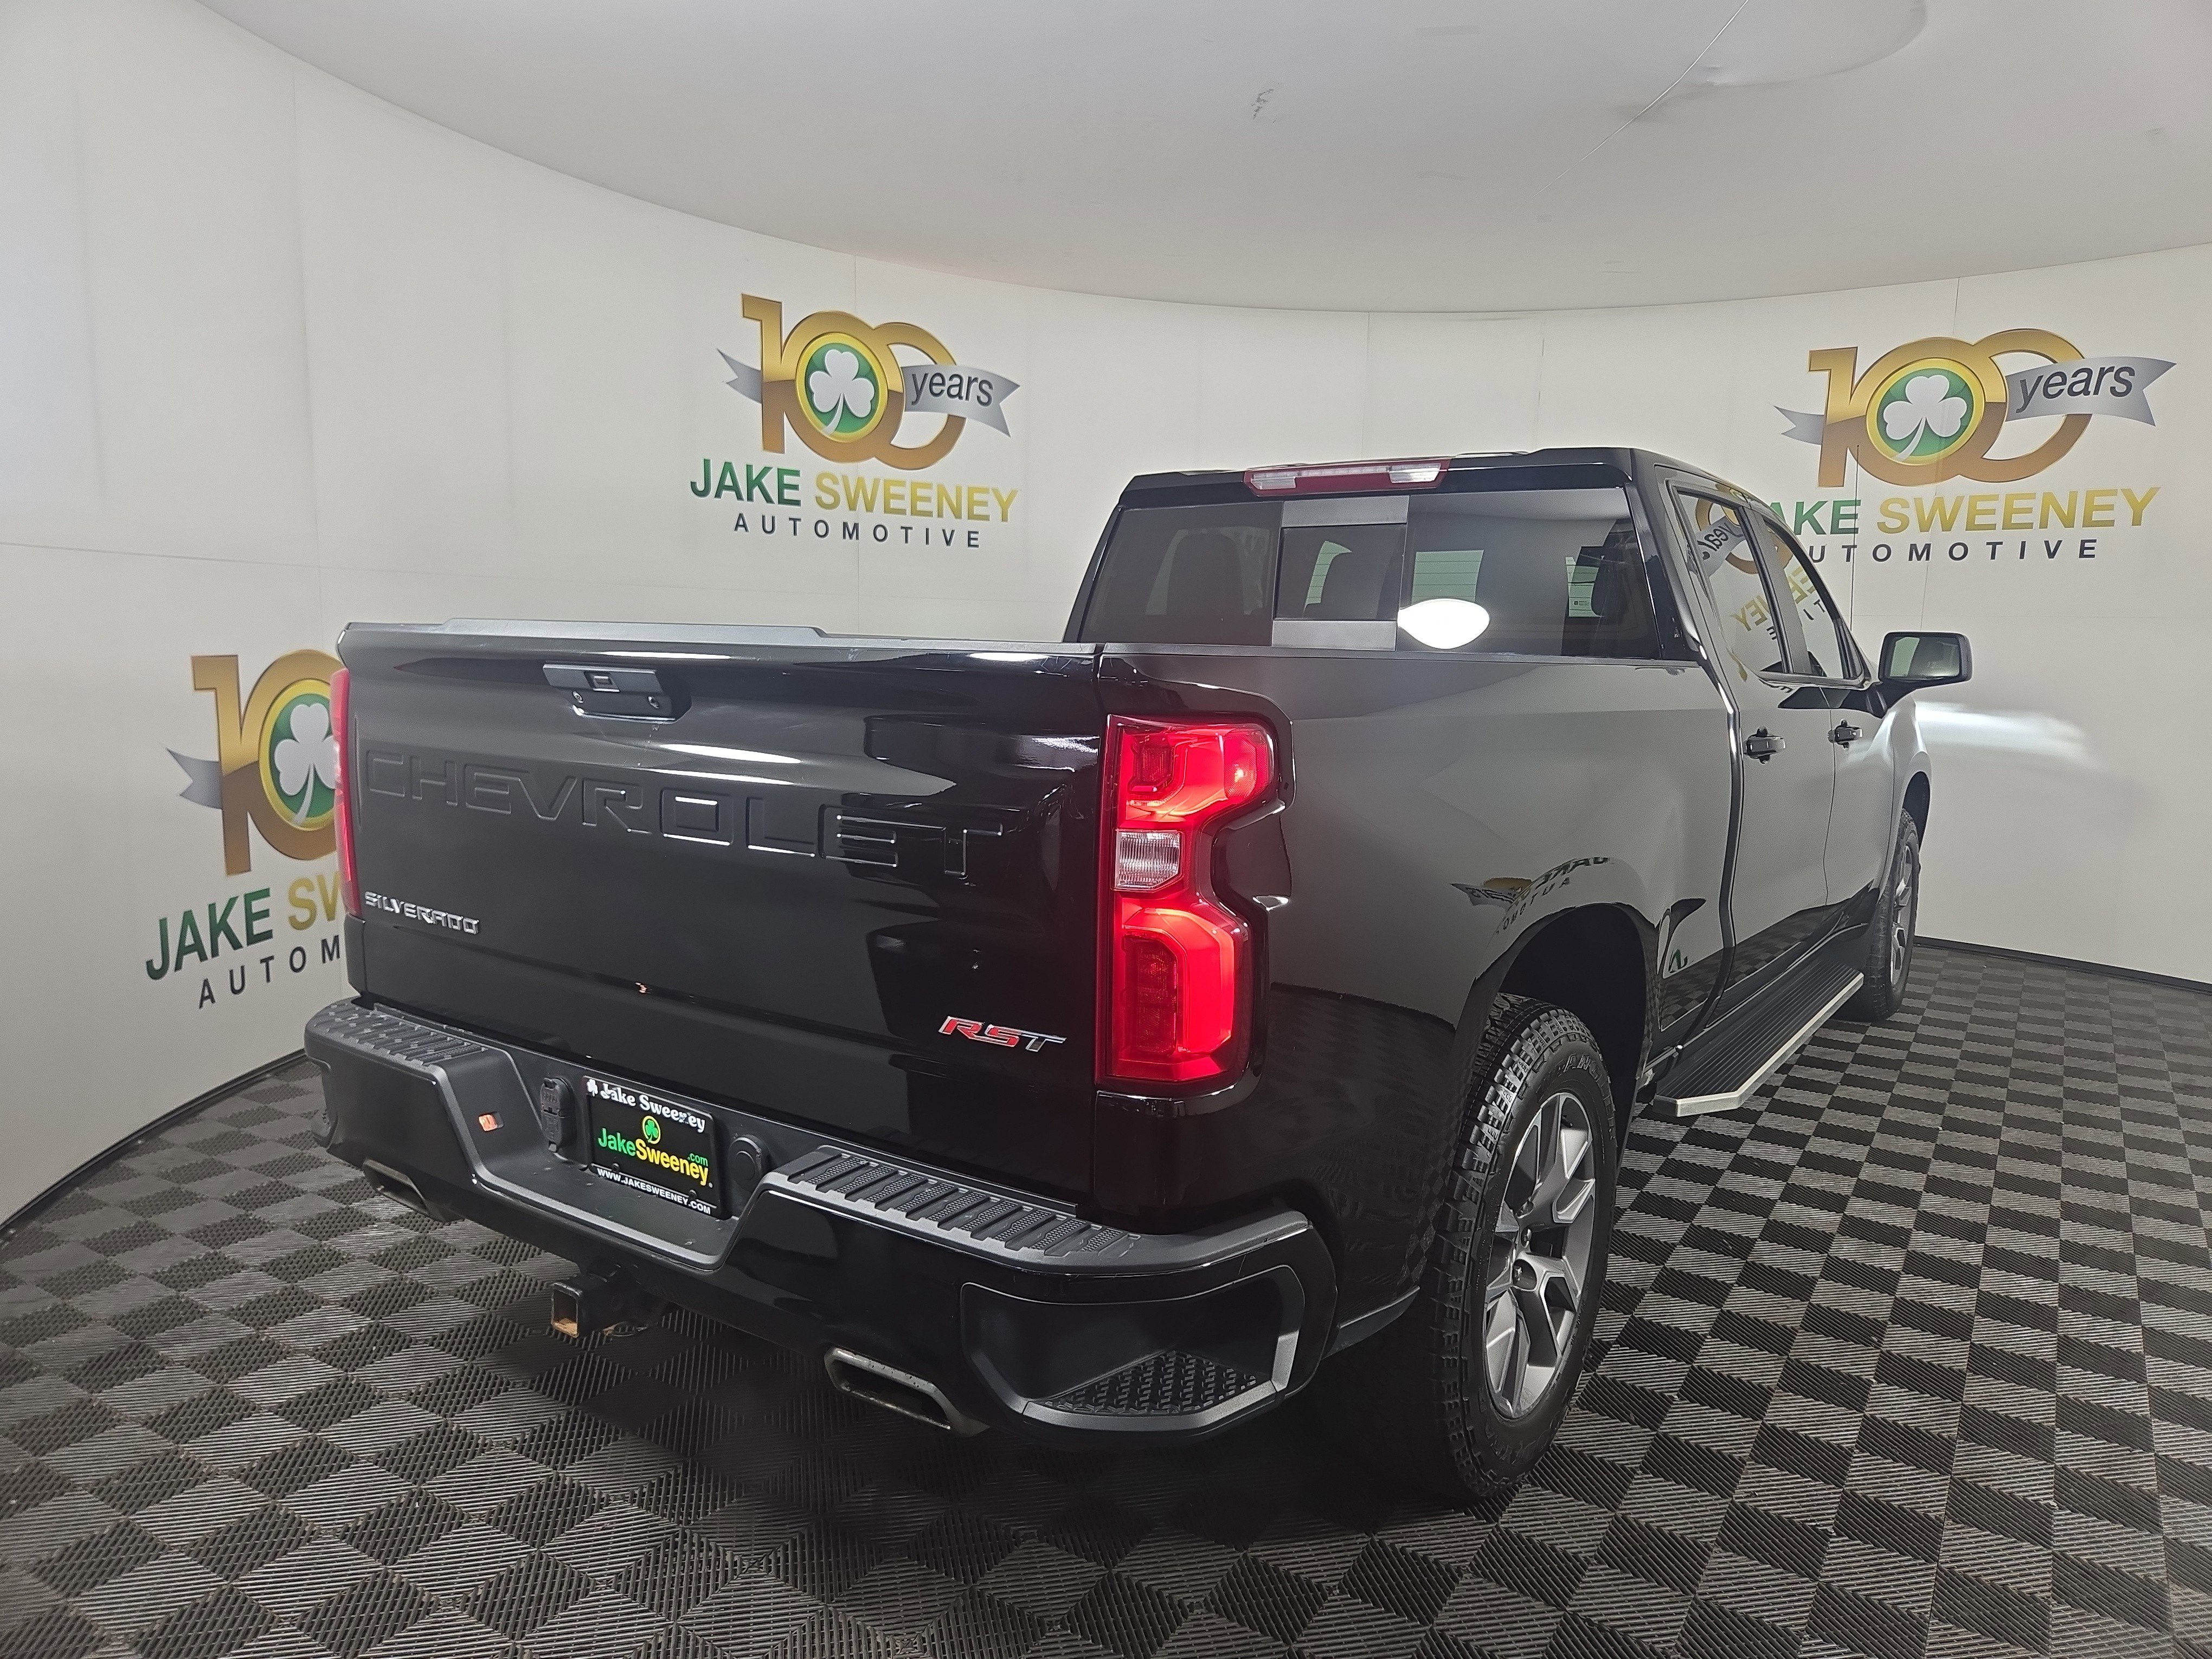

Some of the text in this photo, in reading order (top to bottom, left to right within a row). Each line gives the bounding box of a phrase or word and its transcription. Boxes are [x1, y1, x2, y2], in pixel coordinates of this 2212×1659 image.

[741, 293, 994, 471] 100 years
[1808, 328, 2136, 488] 100 years
[690, 458, 1019, 523] JAKE SWEENEY
[1877, 486, 2161, 534] SWEENEY
[734, 512, 980, 548] AUTOMOTIVE
[1809, 538, 2098, 563] UTOMOTIVE
[365, 748, 1003, 876] CHEVROLET
[145, 888, 273, 980] JAKE
[364, 891, 479, 935] SILVERADO
[198, 934, 340, 1009] AUTOM
[938, 1015, 1067, 1052] RST
[600, 1083, 705, 1133] Jake Sweeney
[598, 1127, 709, 1186] JakeSweeney
[597, 1168, 711, 1215] WWW.JAKESWEENEY.COM
